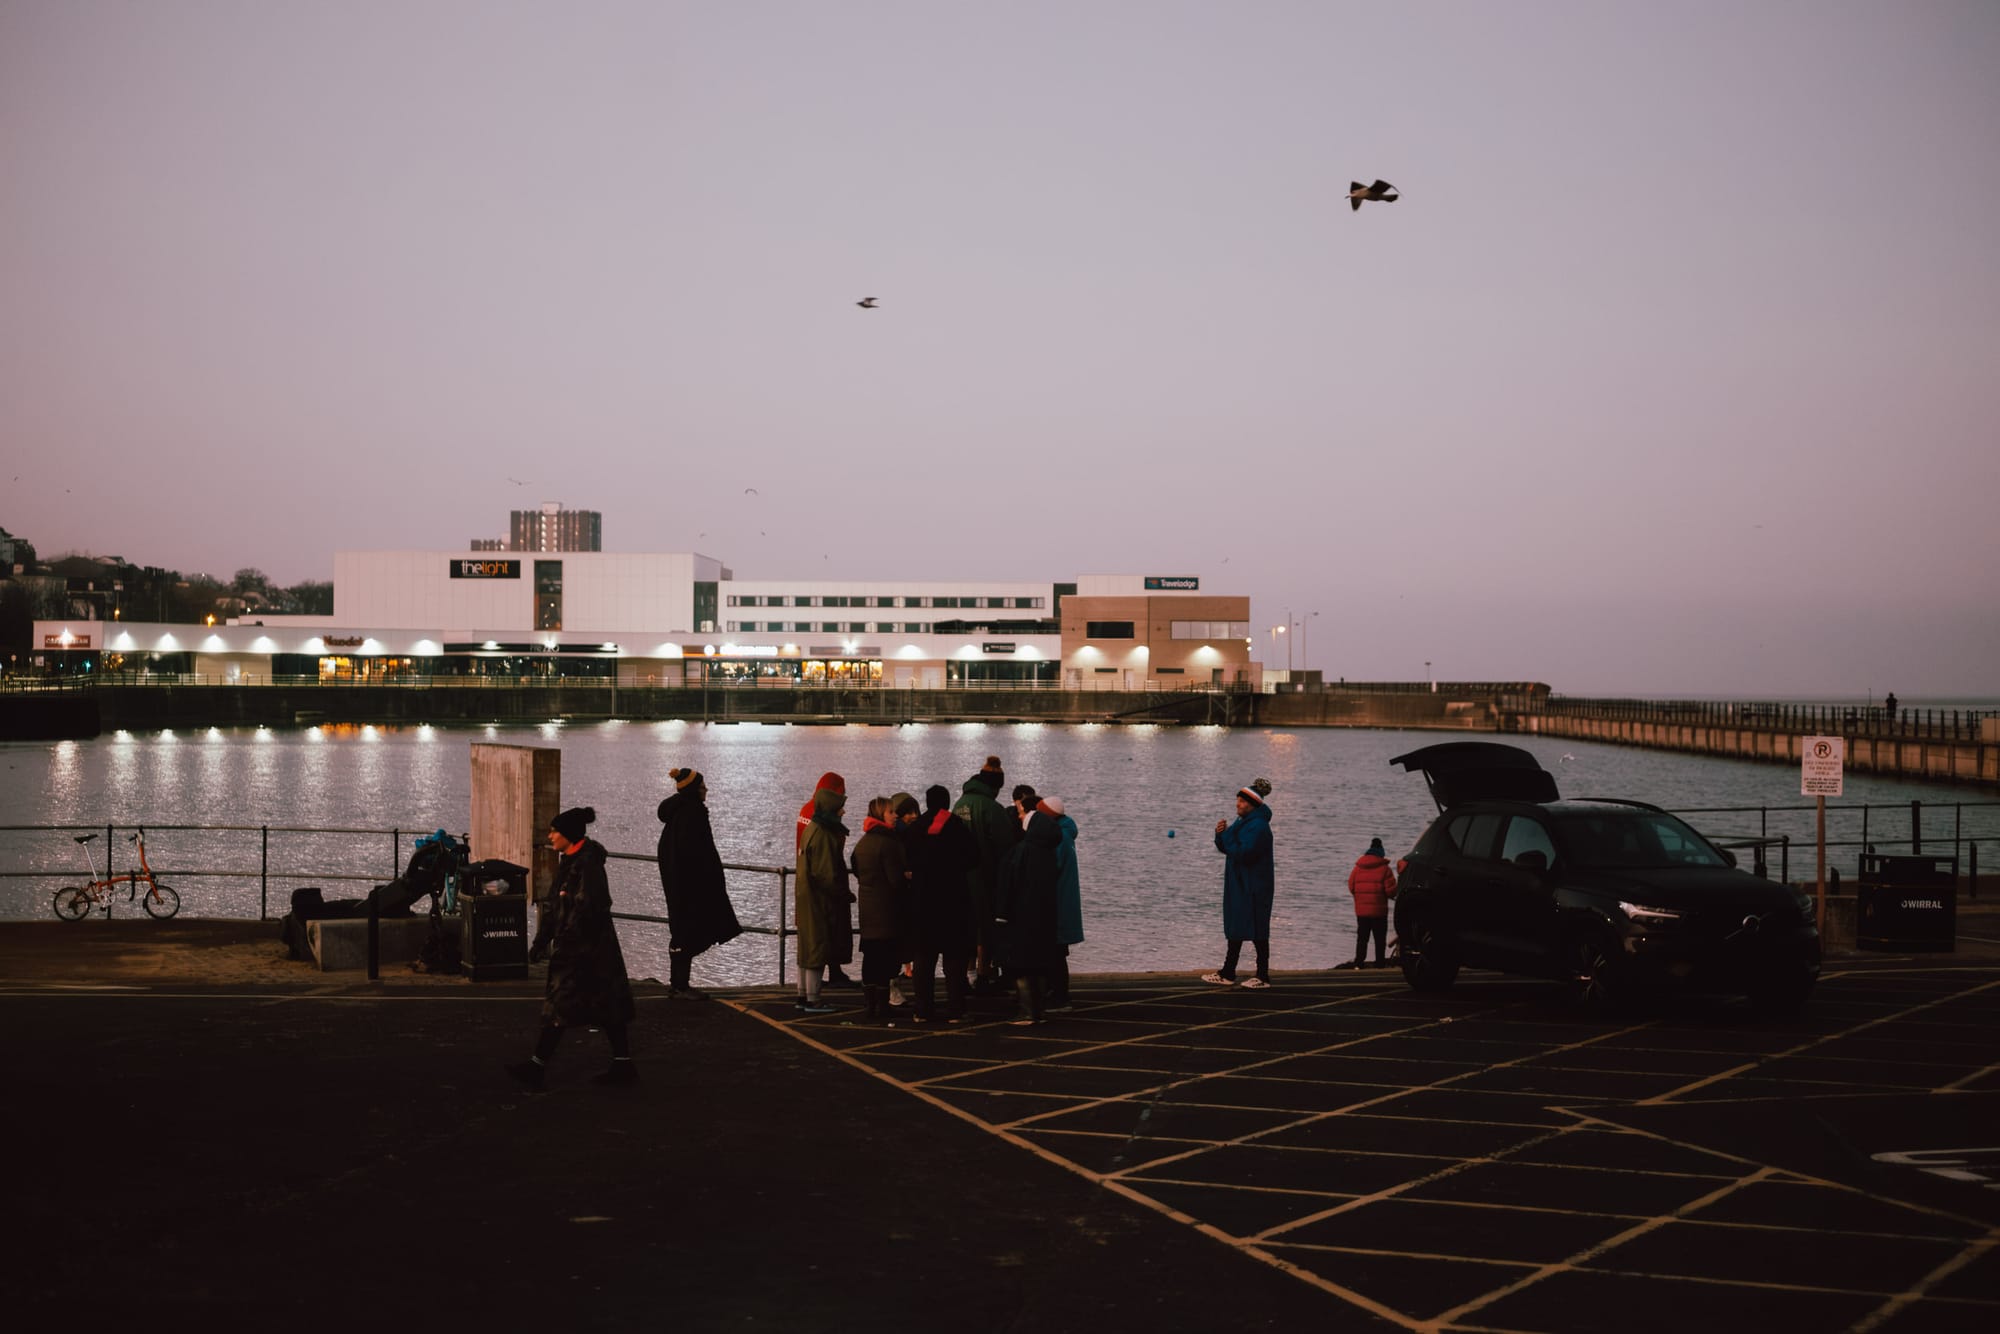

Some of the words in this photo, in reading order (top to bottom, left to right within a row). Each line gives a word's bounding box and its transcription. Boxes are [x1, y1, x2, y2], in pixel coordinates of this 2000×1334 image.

[1160, 578, 1196, 589] Travelodge
[1907, 899, 1943, 909] WIRRAL
[488, 930, 519, 939] WIRRAL
